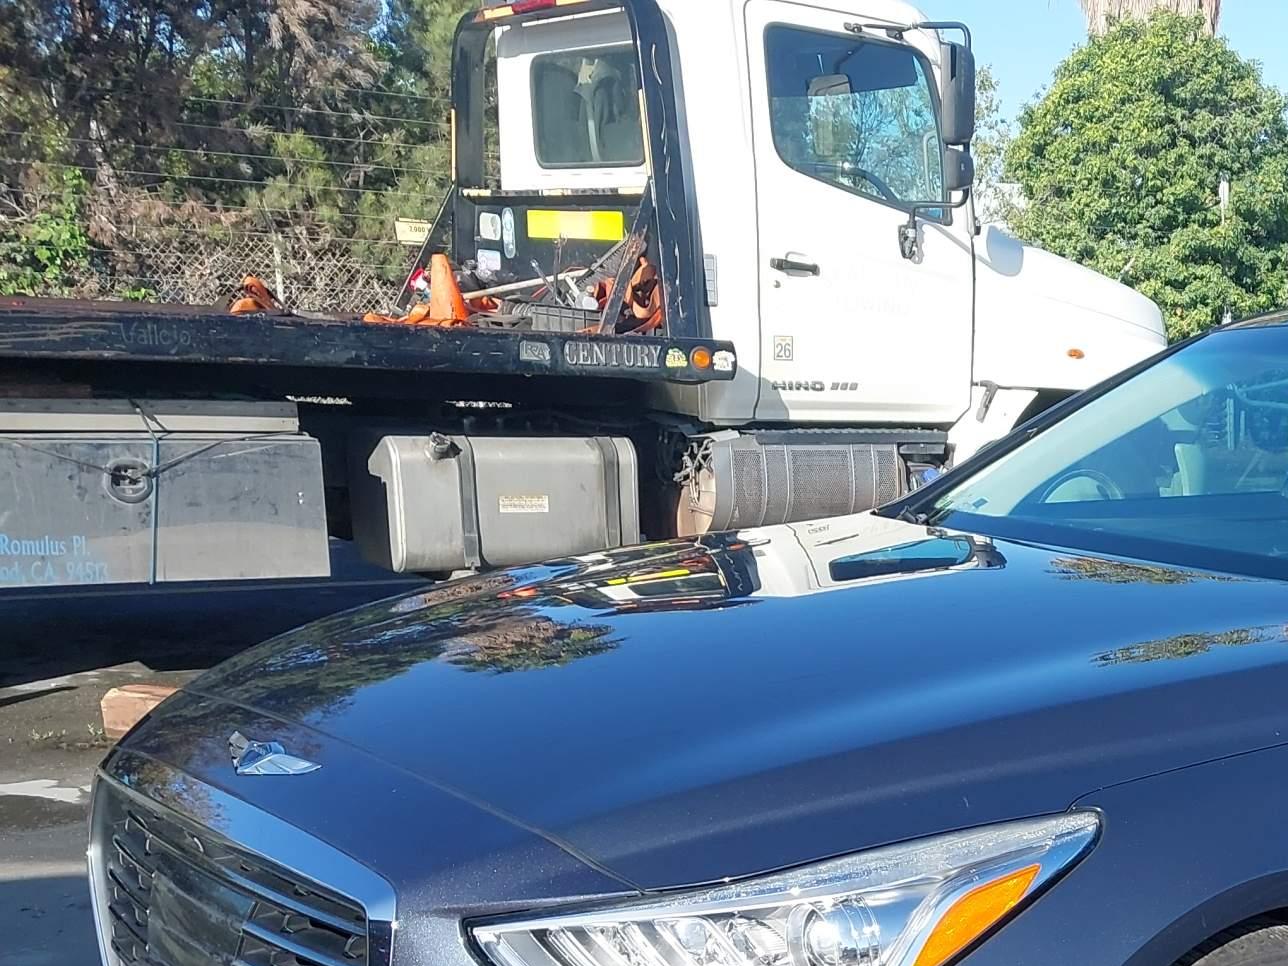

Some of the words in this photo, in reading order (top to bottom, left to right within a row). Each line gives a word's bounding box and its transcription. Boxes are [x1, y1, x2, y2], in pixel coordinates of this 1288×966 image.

[564, 341, 662, 368] CENTURY
[775, 342, 792, 358] 26
[772, 381, 825, 392] HINO
[0, 534, 66, 556] Romulus
[73, 535, 91, 556] Pl.
[31, 560, 54, 581] CA
